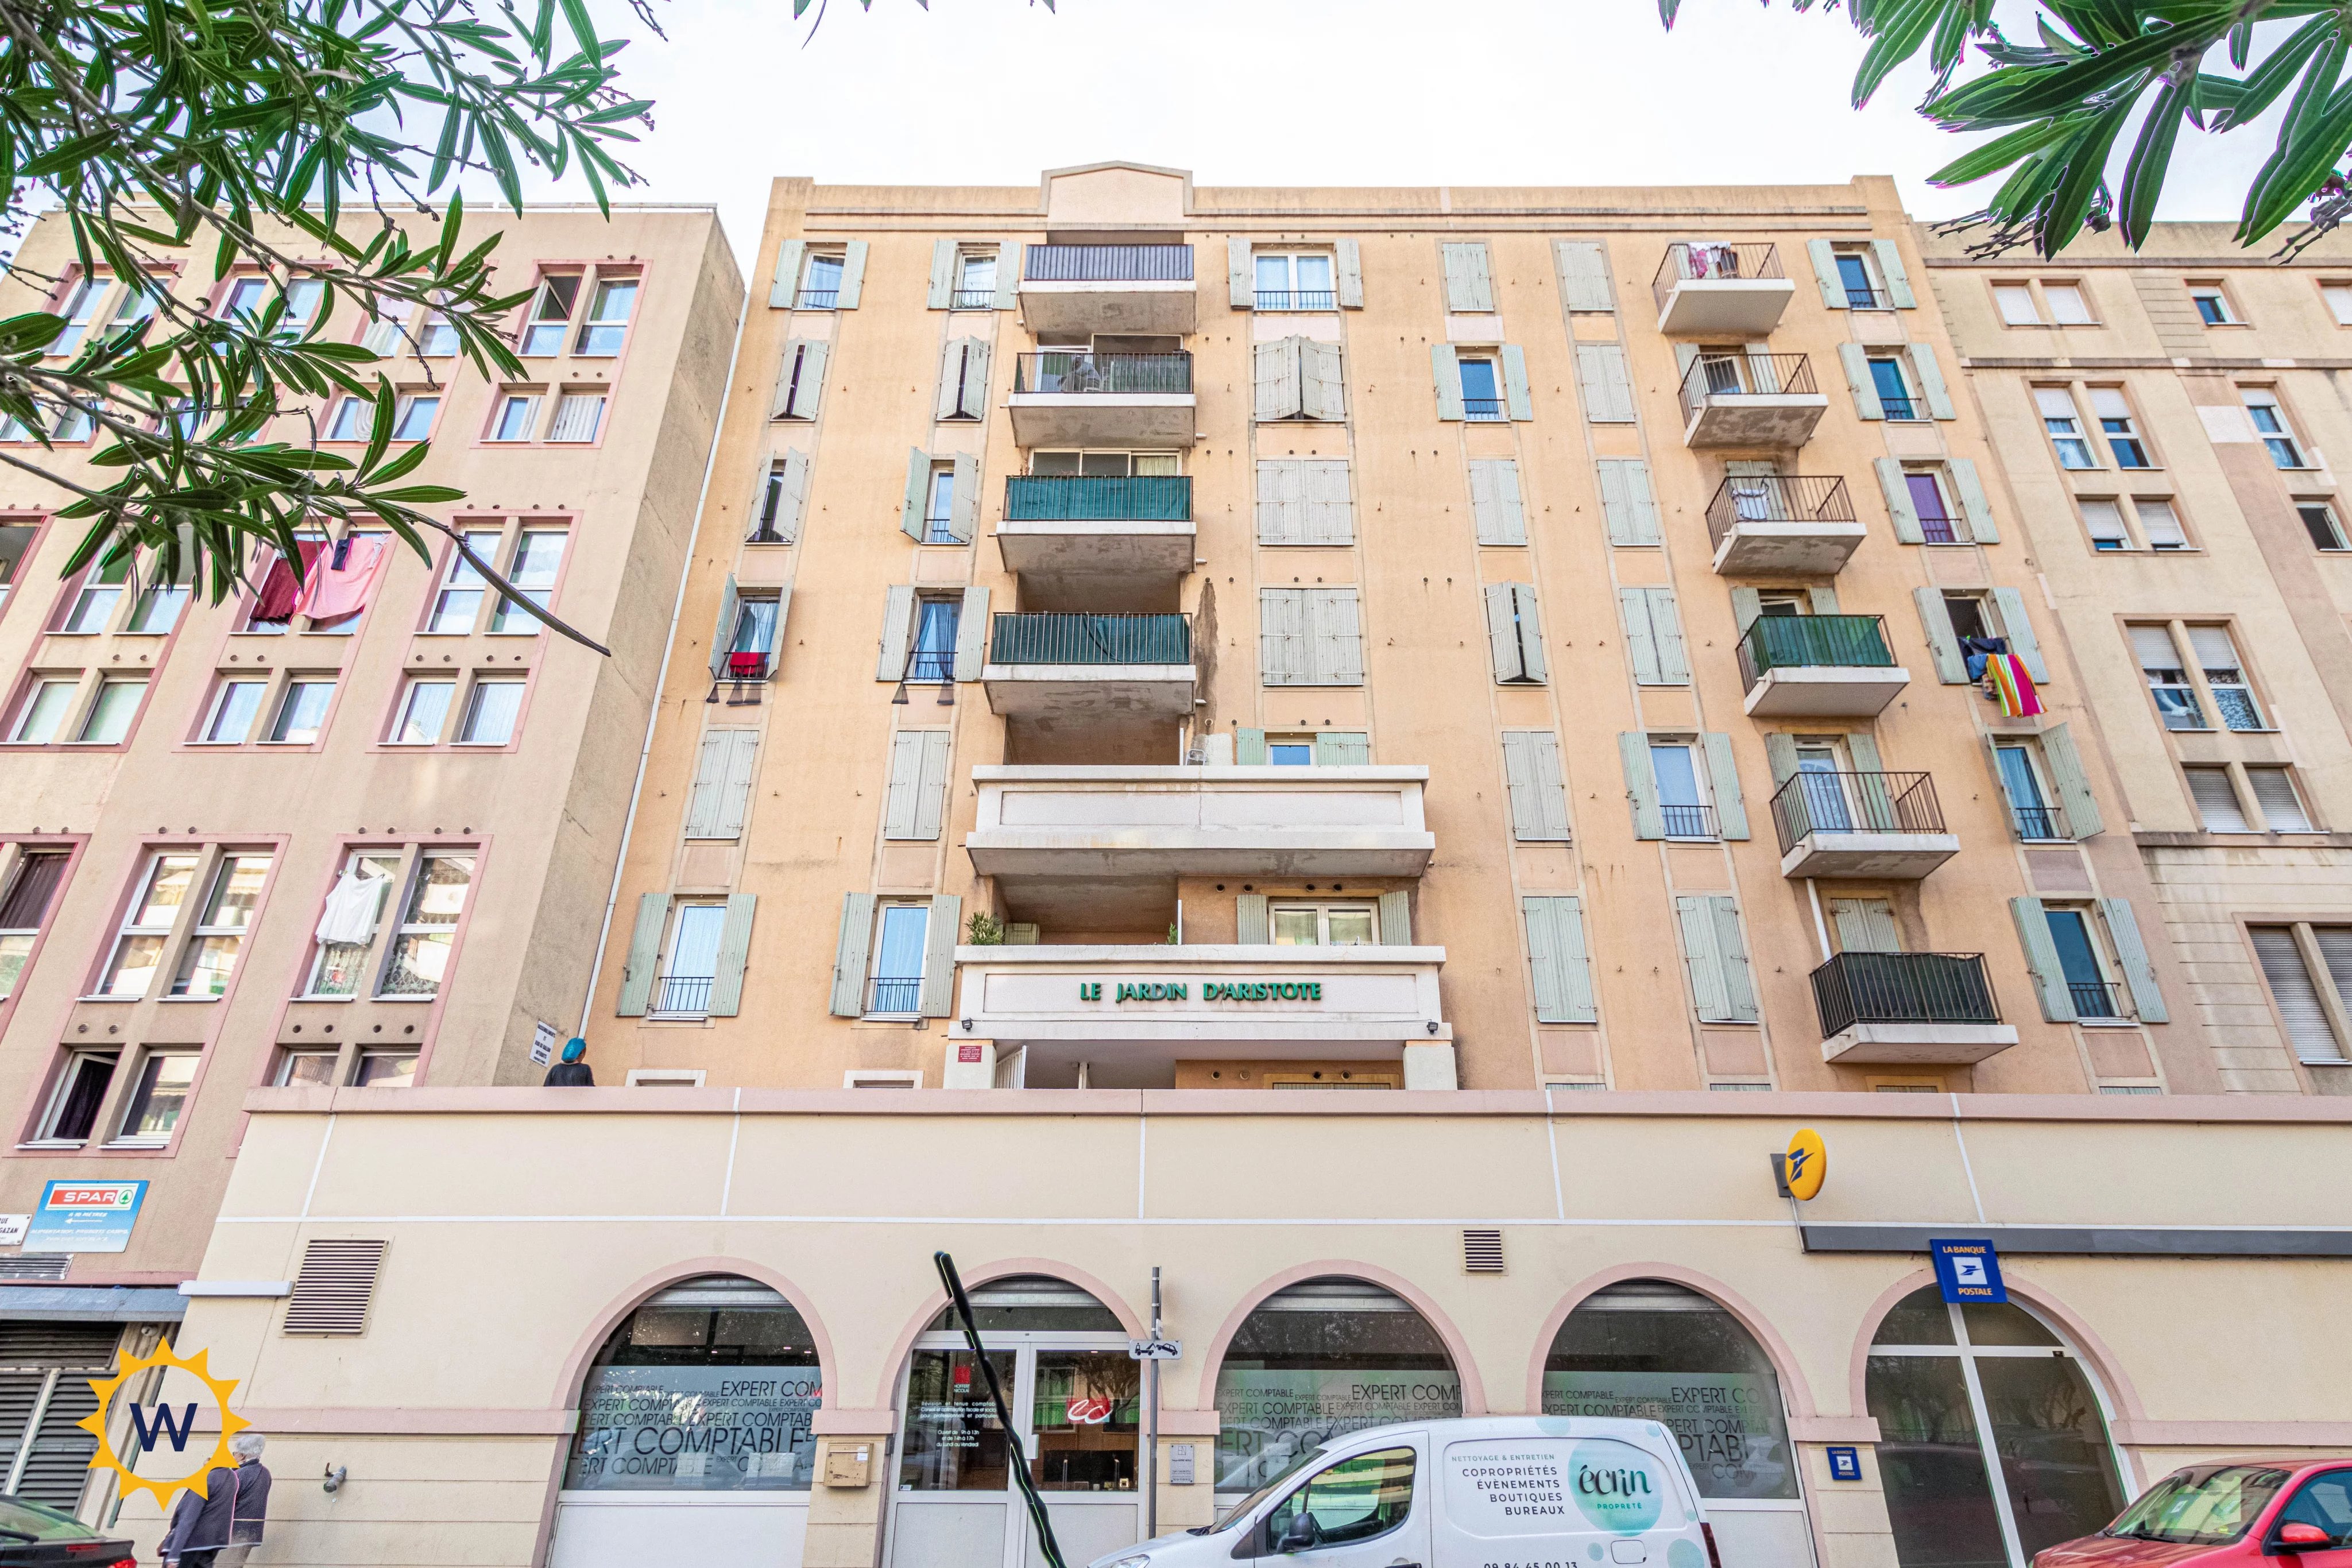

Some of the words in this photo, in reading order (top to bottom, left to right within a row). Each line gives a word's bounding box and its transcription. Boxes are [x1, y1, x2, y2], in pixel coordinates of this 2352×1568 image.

[1080, 982, 1101, 1001] LE
[1116, 982, 1187, 1004] JARDIN
[1203, 982, 1321, 1001] D'ARISTOTE
[63, 1191, 117, 1203] SPAR
[1953, 1246, 1987, 1255] BANQUE
[721, 1381, 777, 1396] EXPERT
[1216, 1389, 1244, 1397] EXPERT
[1245, 1389, 1294, 1397] COMPTABLE
[1352, 1385, 1407, 1400] EXPERT
[1566, 1391, 1614, 1399] COMPTABLE
[1672, 1387, 1726, 1403] EXPERT
[583, 1399, 626, 1411] EXPERT
[702, 1399, 730, 1407] EXPERT
[731, 1399, 777, 1407] COMPTABLE
[780, 1399, 807, 1407] EXPERT
[1217, 1402, 1259, 1414] EXPERT
[1263, 1402, 1334, 1414] COMPTABLE
[1365, 1402, 1411, 1410] COMPTABLE
[1414, 1402, 1440, 1410] EXPERT
[1658, 1405, 1684, 1413] EXPERT
[1584, 1404, 1657, 1417] COMPTABLE
[1250, 1417, 1322, 1429] COMPTABLE
[635, 1426, 805, 1455] COMPTABLE
[1462, 1465, 1557, 1477] COPROPRIÉTÉS
[1477, 1479, 1560, 1489] ÉVÈNEMENTS
[1579, 1464, 1652, 1497] écrin
[1490, 1493, 1562, 1503] BOUTIQUES
[1505, 1506, 1565, 1515] BUREAUX
[1597, 1501, 1642, 1509] PROPRETÉ
